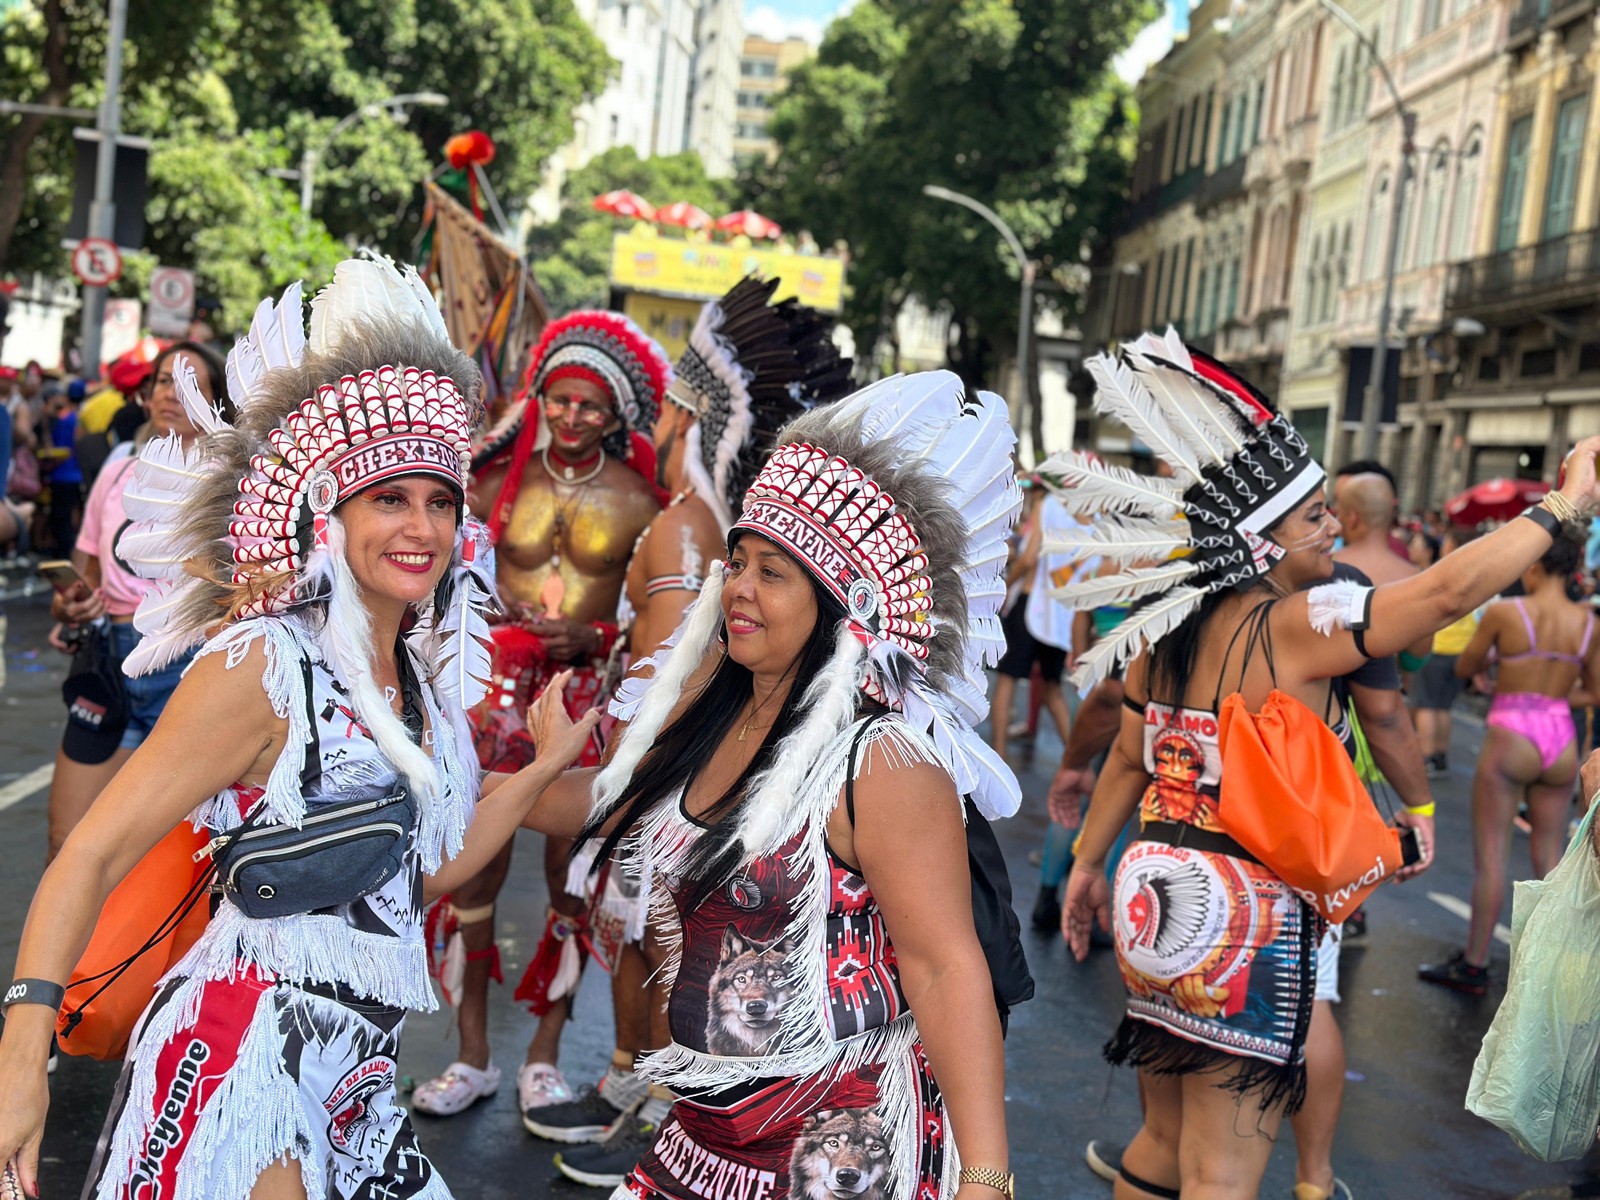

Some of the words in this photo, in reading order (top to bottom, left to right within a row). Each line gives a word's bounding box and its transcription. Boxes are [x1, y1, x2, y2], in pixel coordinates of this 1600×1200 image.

[70, 703, 102, 725] POLO
[1324, 856, 1385, 913] kwai
[345, 1071, 360, 1089] DE
[129, 1038, 211, 1200] Cheyenne
[654, 1119, 777, 1200] CHEYENNE
